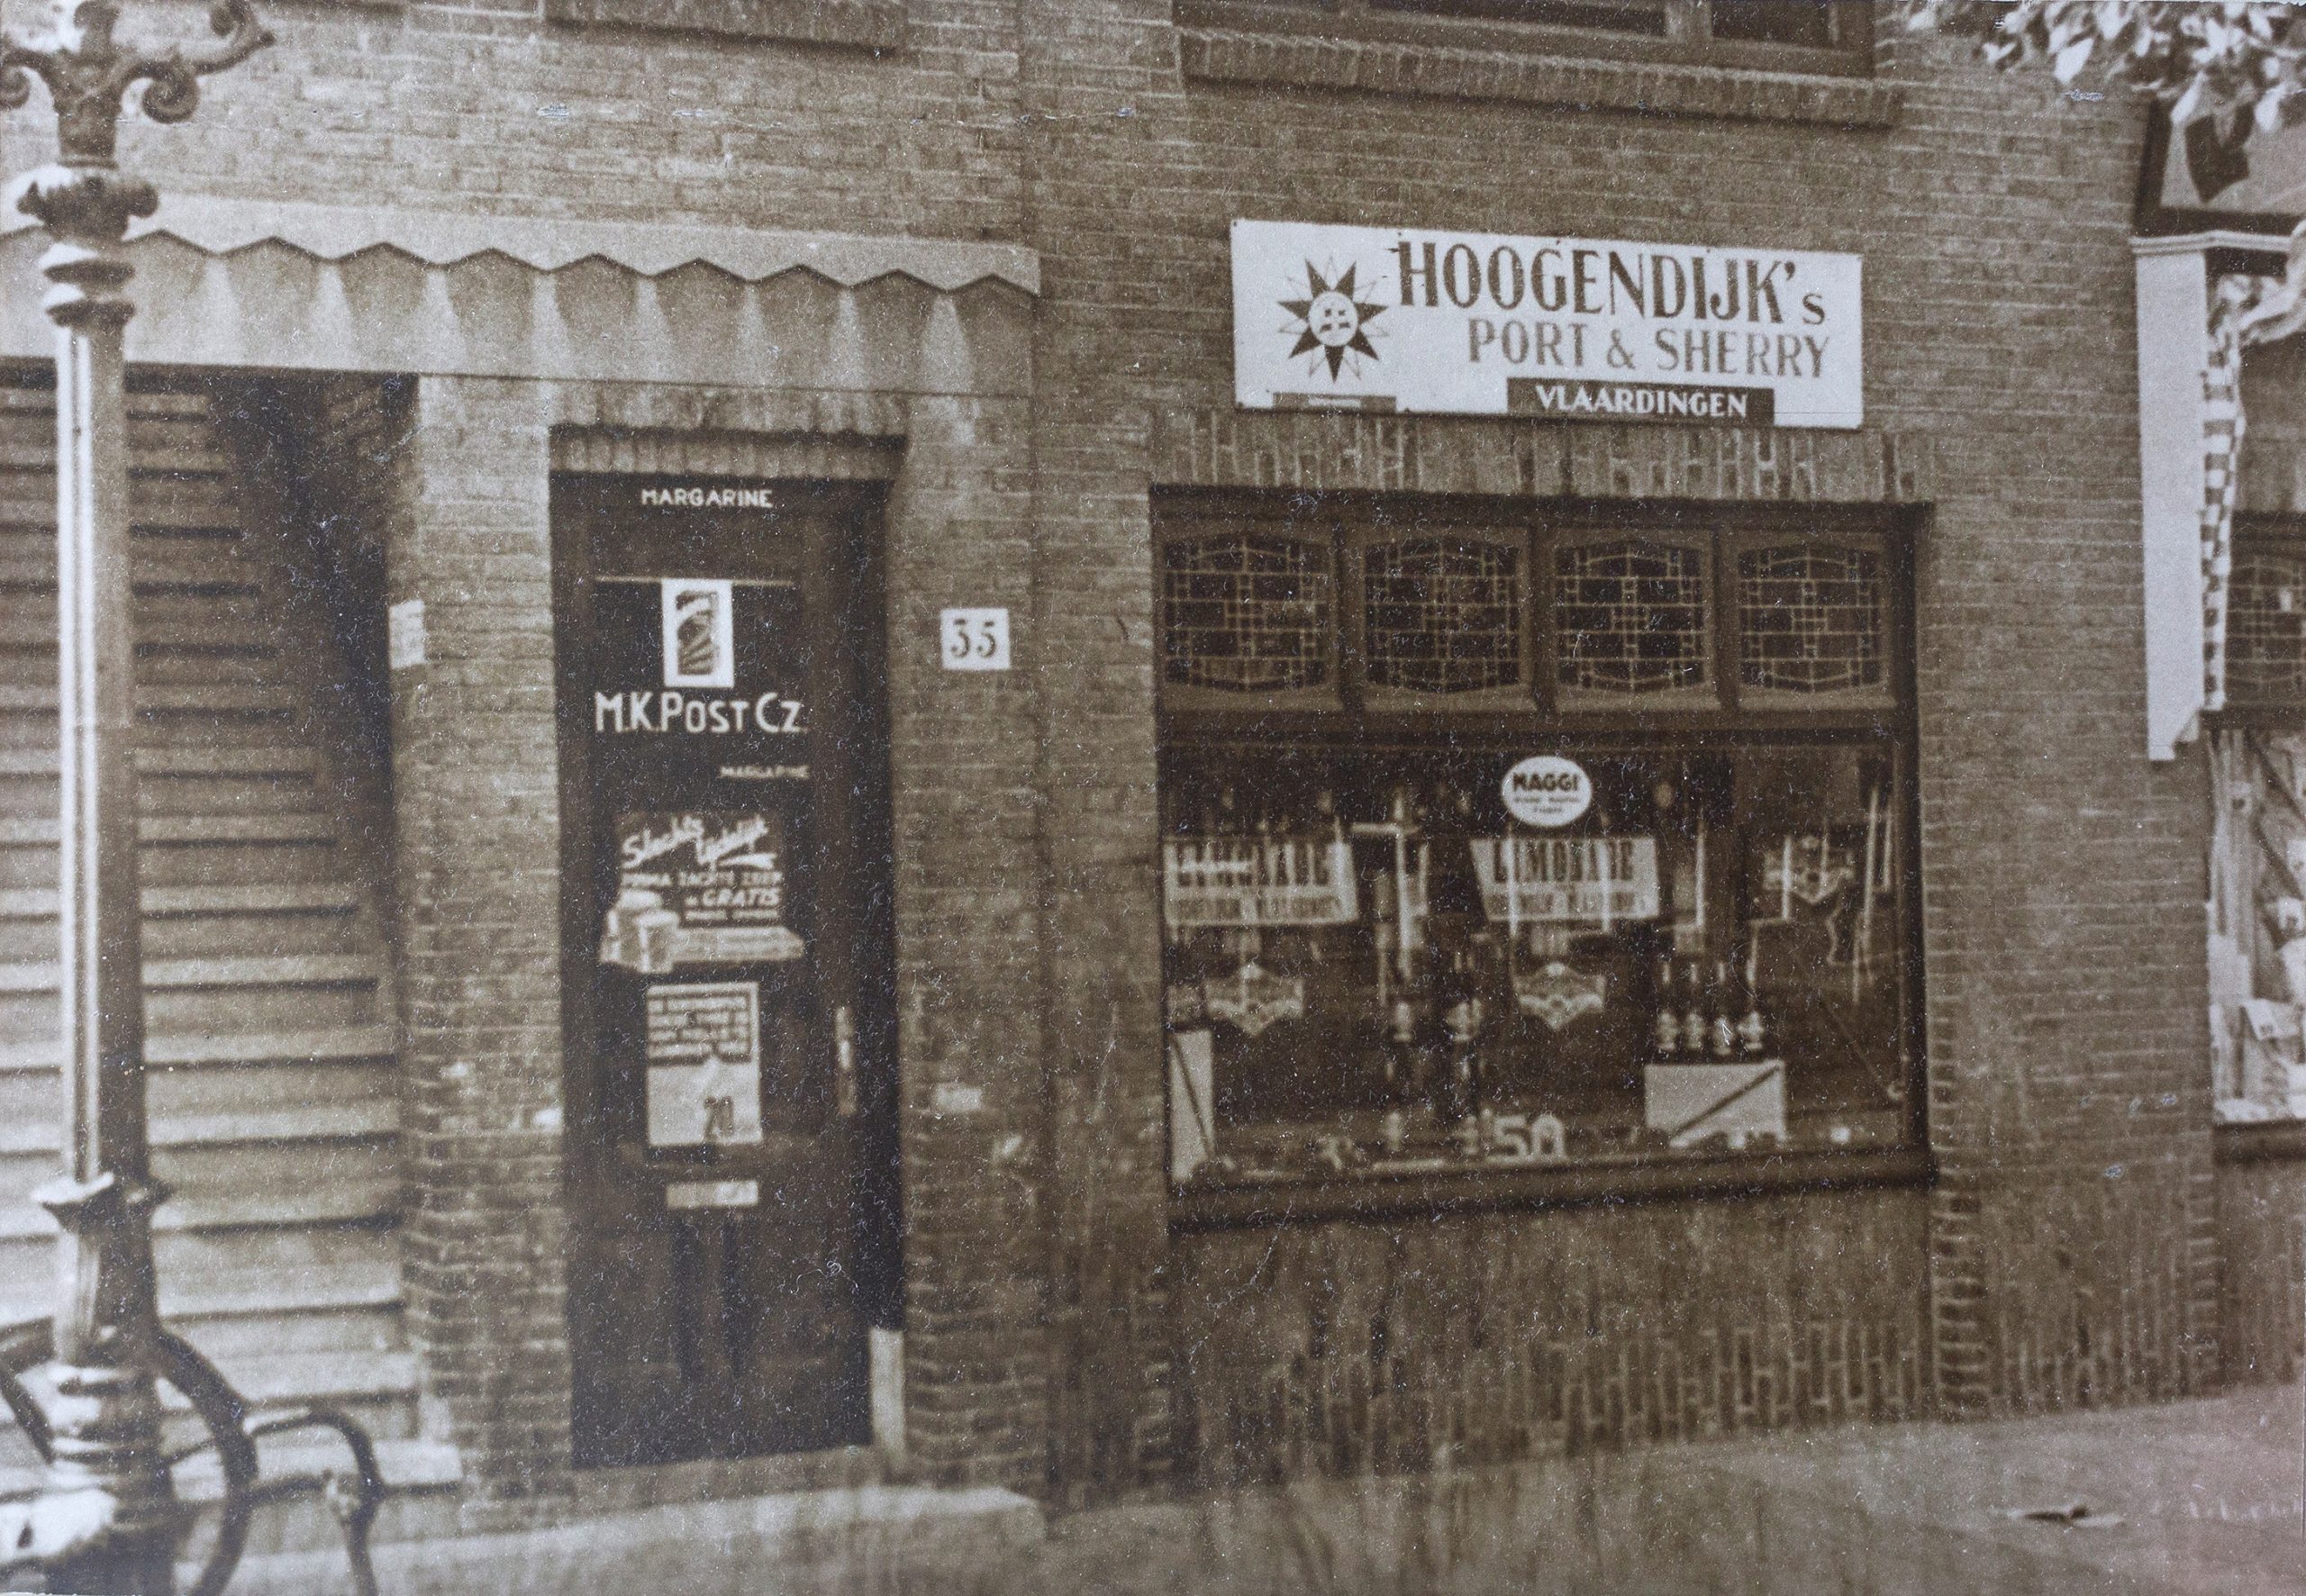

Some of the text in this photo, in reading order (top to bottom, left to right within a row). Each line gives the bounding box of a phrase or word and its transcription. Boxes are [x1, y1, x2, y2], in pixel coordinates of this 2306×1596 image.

[1398, 240, 1826, 325] HOOGENDIJK's
[1468, 318, 1829, 377] PORT & SHERRY
[1535, 385, 1748, 418] VLAARDINGEN
[640, 488, 773, 508] MARGARINE
[1512, 772, 1579, 792] MAGGI
